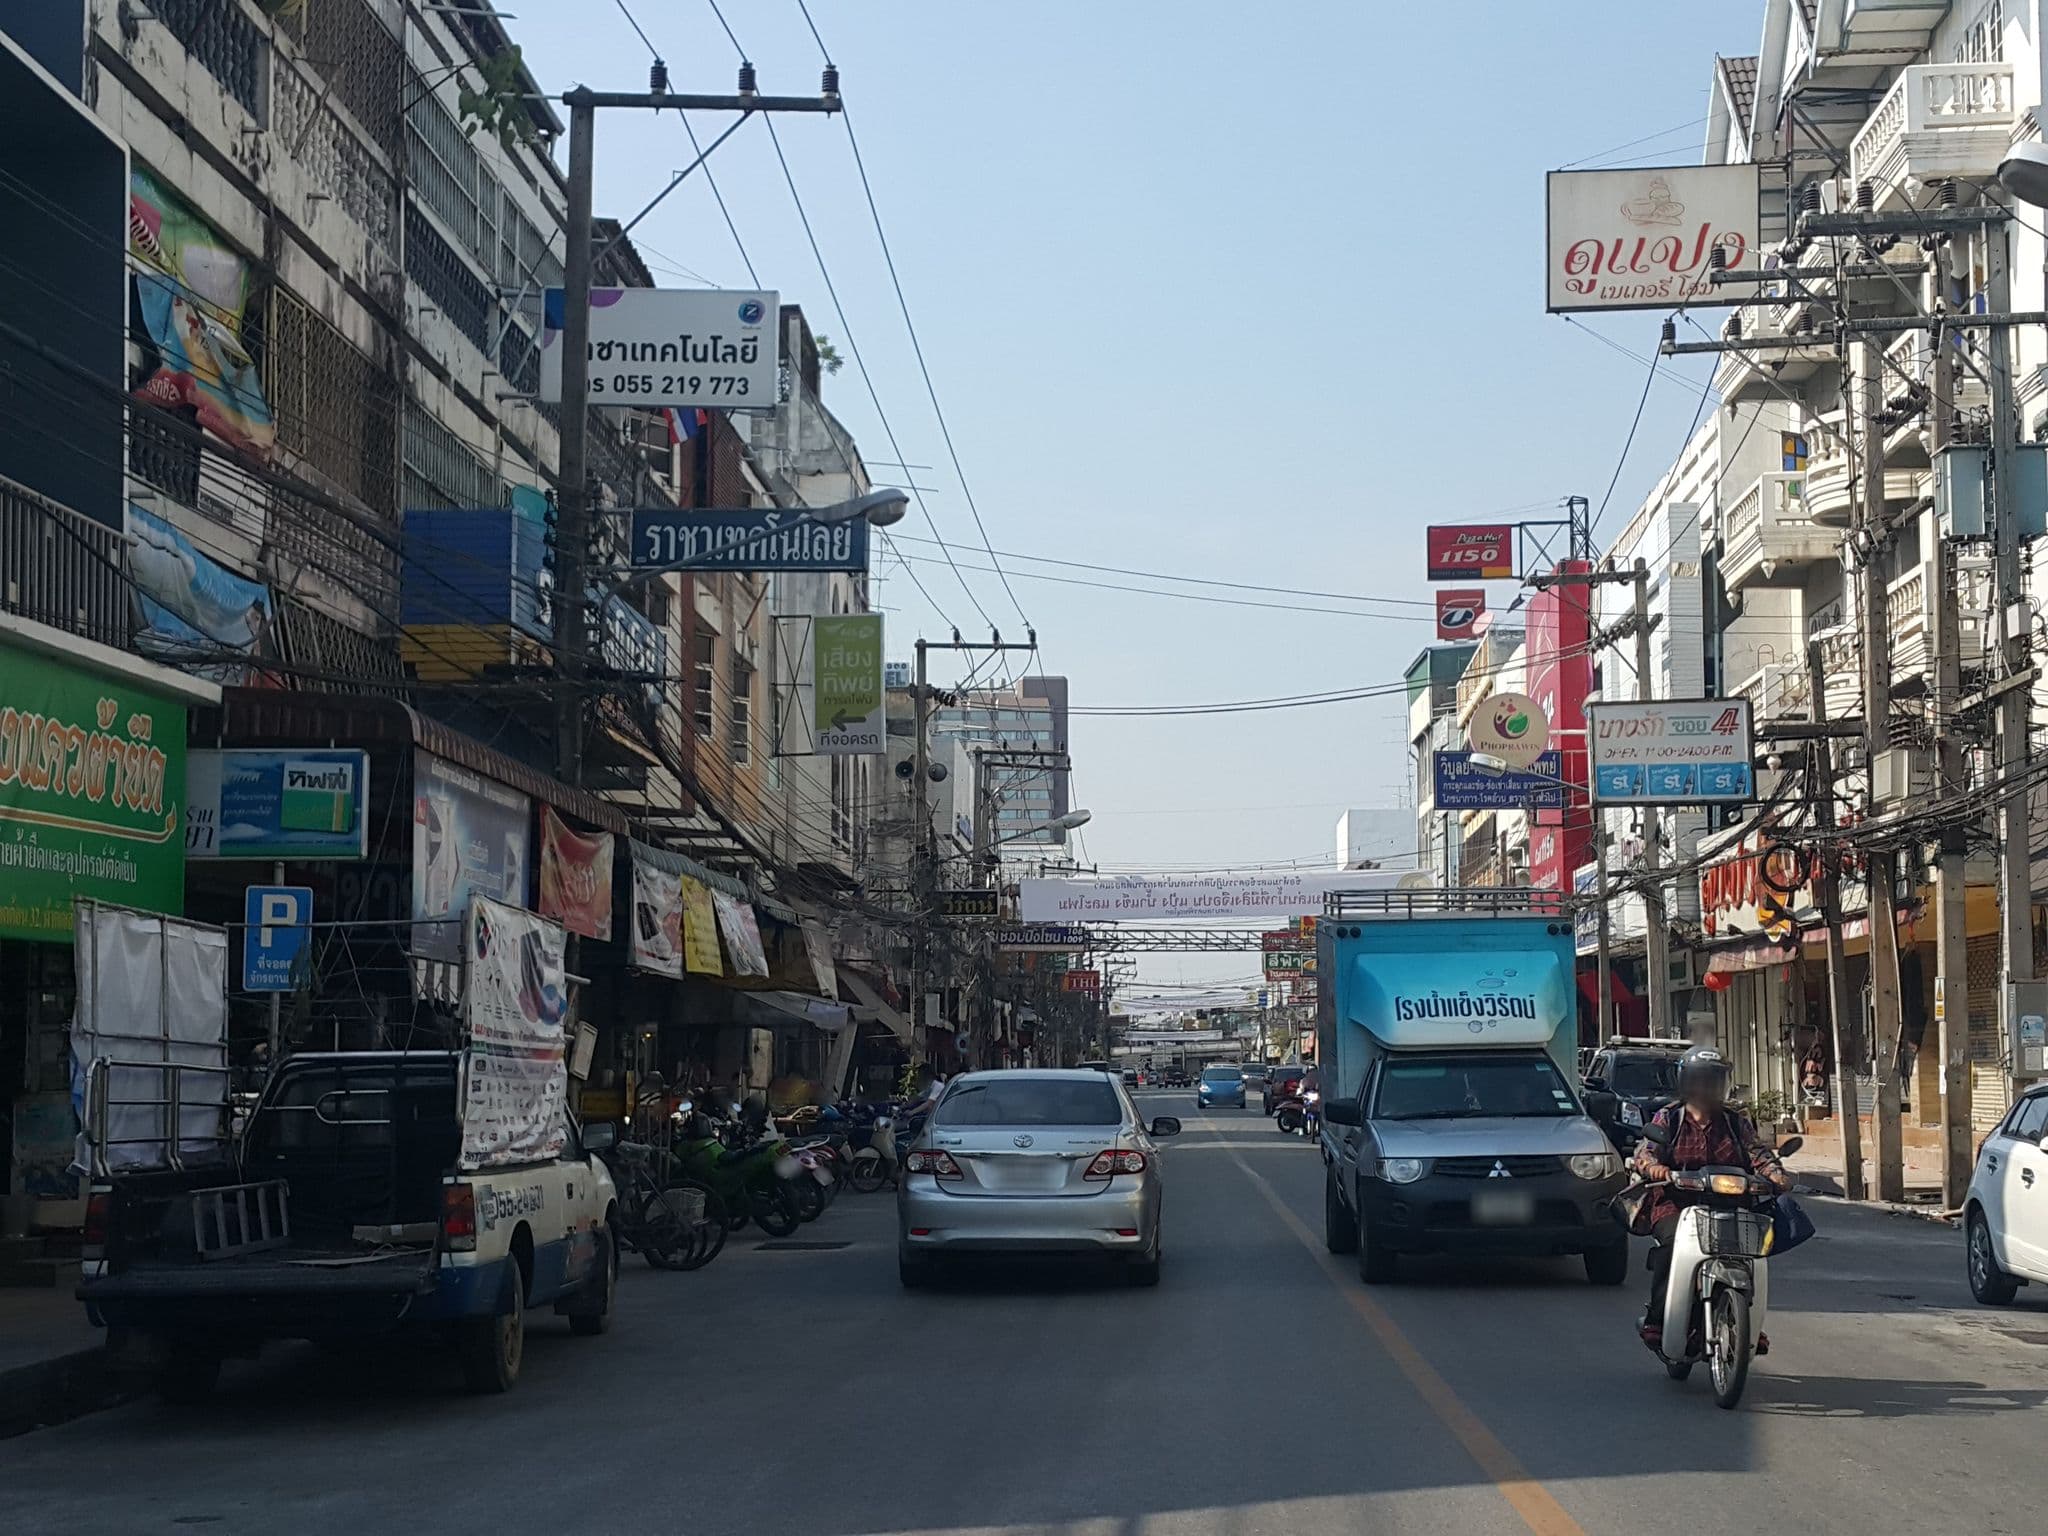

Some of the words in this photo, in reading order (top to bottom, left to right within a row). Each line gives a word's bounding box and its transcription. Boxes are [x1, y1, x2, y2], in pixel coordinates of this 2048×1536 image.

[1600, 275, 1675, 300] เบเกอรี่
[613, 374, 653, 395] 055
[661, 375, 701, 395] 219
[710, 376, 749, 396] 773
[1439, 549, 1499, 563] 1150
[823, 646, 873, 669] เสียง
[823, 670, 874, 693] ทิพย์
[1599, 710, 1665, 739] บางรัก
[1710, 707, 1741, 736] 4
[820, 727, 879, 747] ที่จอดรถ
[260, 894, 299, 948] P
[1063, 935, 1084, 944] 1009
[1394, 989, 1537, 1022] โรงน้ำแข็งวิรัตน์
